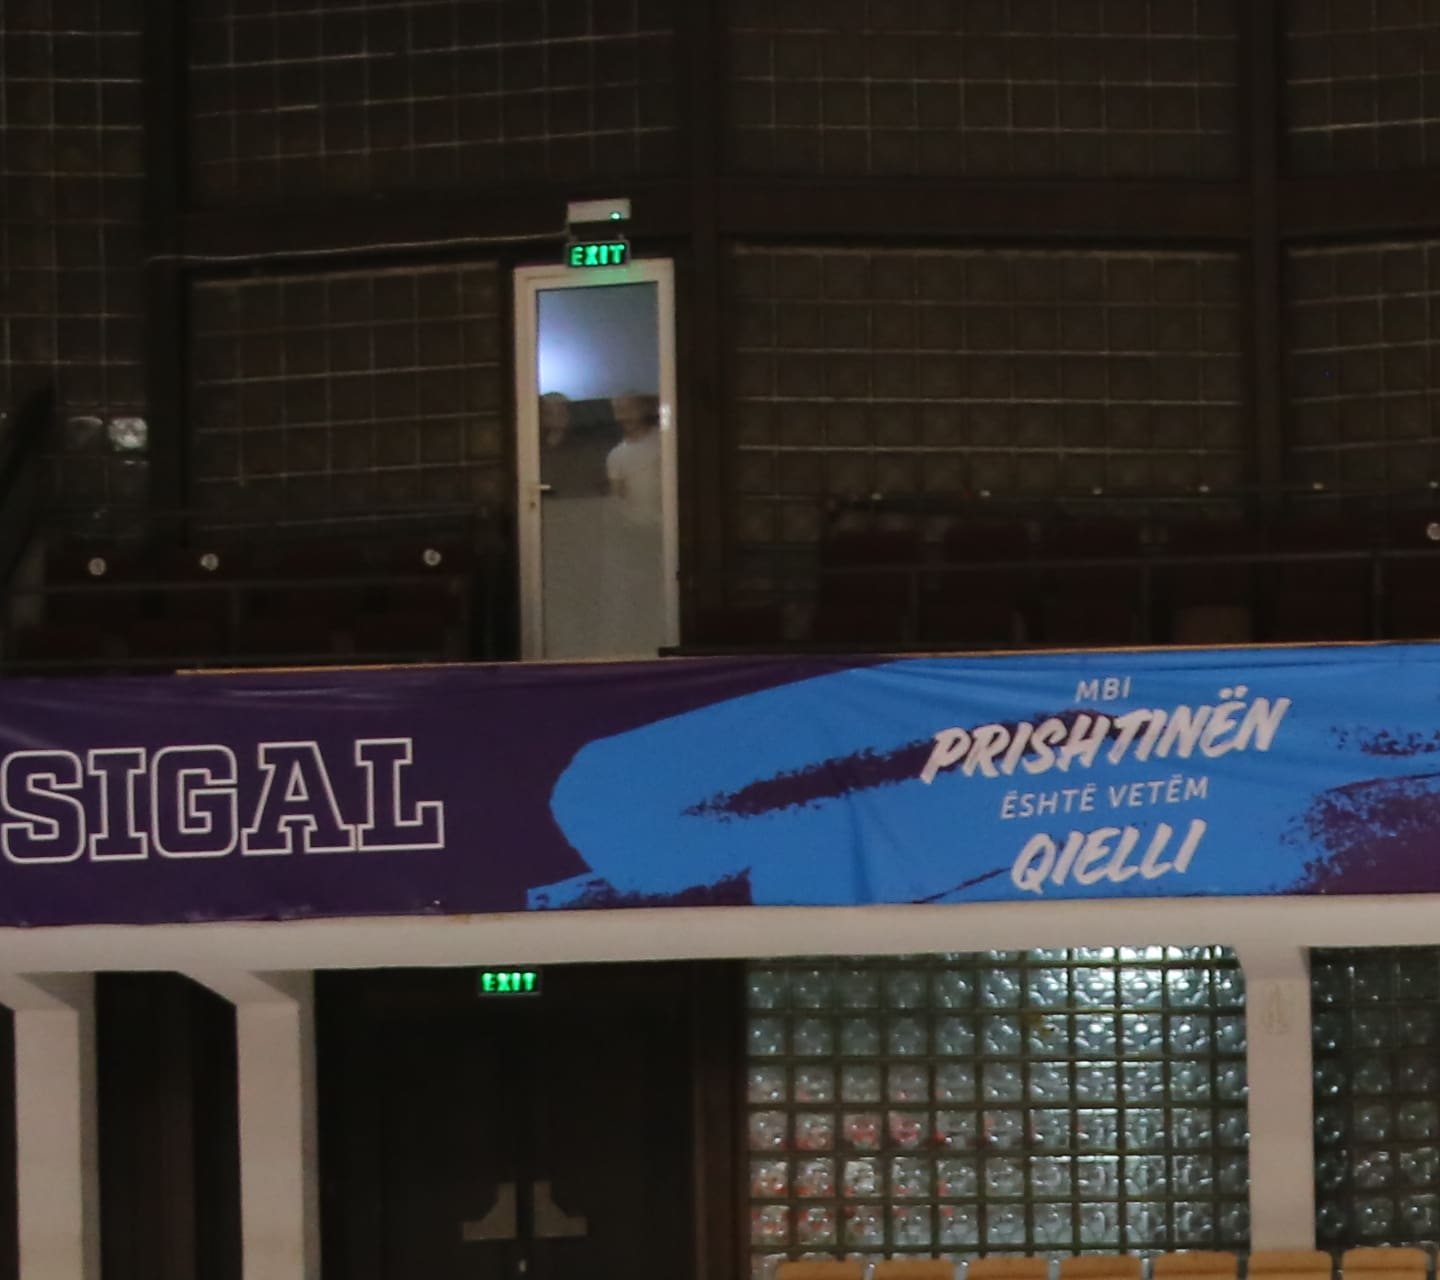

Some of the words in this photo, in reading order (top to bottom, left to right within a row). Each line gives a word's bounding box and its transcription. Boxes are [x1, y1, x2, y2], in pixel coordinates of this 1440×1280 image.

[570, 243, 625, 267] EXIT
[1076, 676, 1131, 703] MBI
[920, 685, 1291, 784] PRISHTINËN
[0, 737, 445, 864] SIGAL
[1000, 782, 1097, 819] ËSHTË
[1108, 774, 1208, 809] VETËM
[1011, 819, 1207, 894] QIELLI
[481, 971, 537, 992] EXIT
